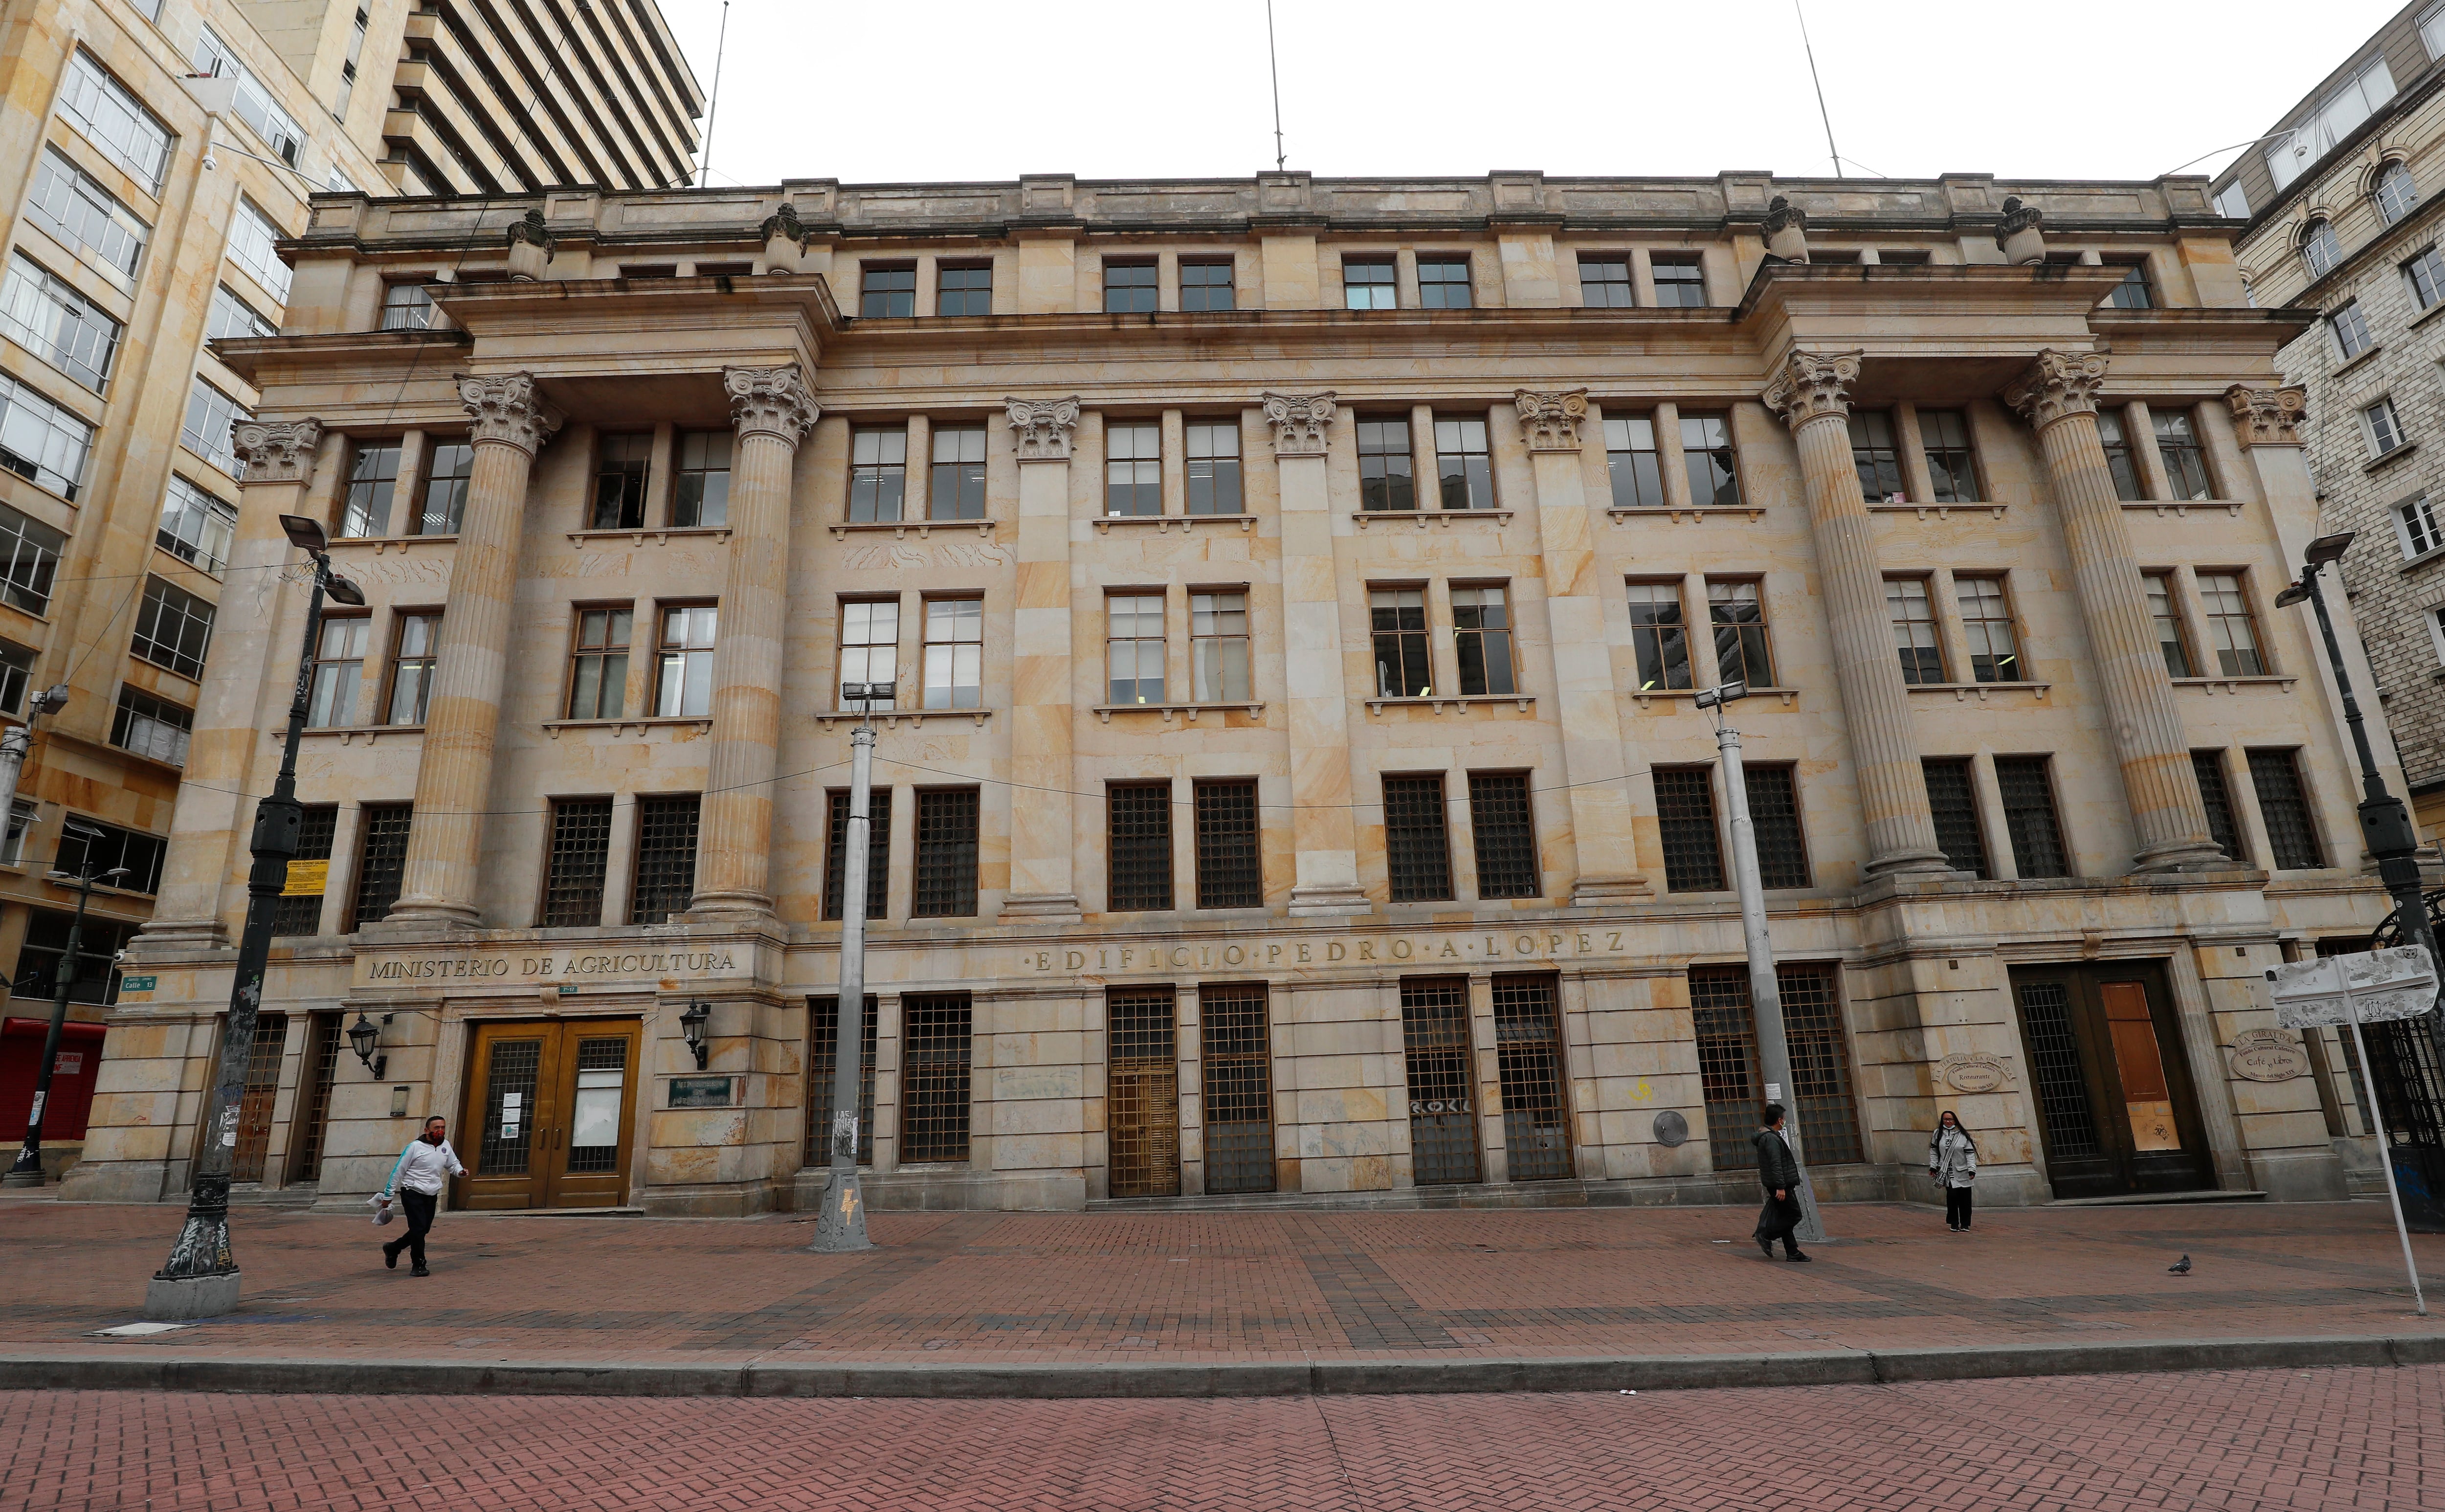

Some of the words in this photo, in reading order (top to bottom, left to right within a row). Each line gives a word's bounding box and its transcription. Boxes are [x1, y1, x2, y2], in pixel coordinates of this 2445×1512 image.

[1035, 944, 1245, 971] EDIFICIO
[1266, 938, 1413, 963] PEDRO
[1439, 938, 1459, 957] A
[1485, 932, 1624, 956] LOPEZ
[370, 959, 510, 978] MINISTERIO
[521, 957, 553, 975] DE
[563, 953, 736, 974] AGRICULTURA
[2239, 1036, 2250, 1045] LA
[2252, 1031, 2291, 1044] GIRALDA
[2274, 1045, 2295, 1054] Cafetero
[1935, 1069, 1942, 1078] LA
[1941, 1056, 1967, 1068] TERTULIA
[1986, 1056, 2013, 1076] GIRALDA
[2247, 1056, 2266, 1067] Café
[2273, 1055, 2293, 1065] Libros
